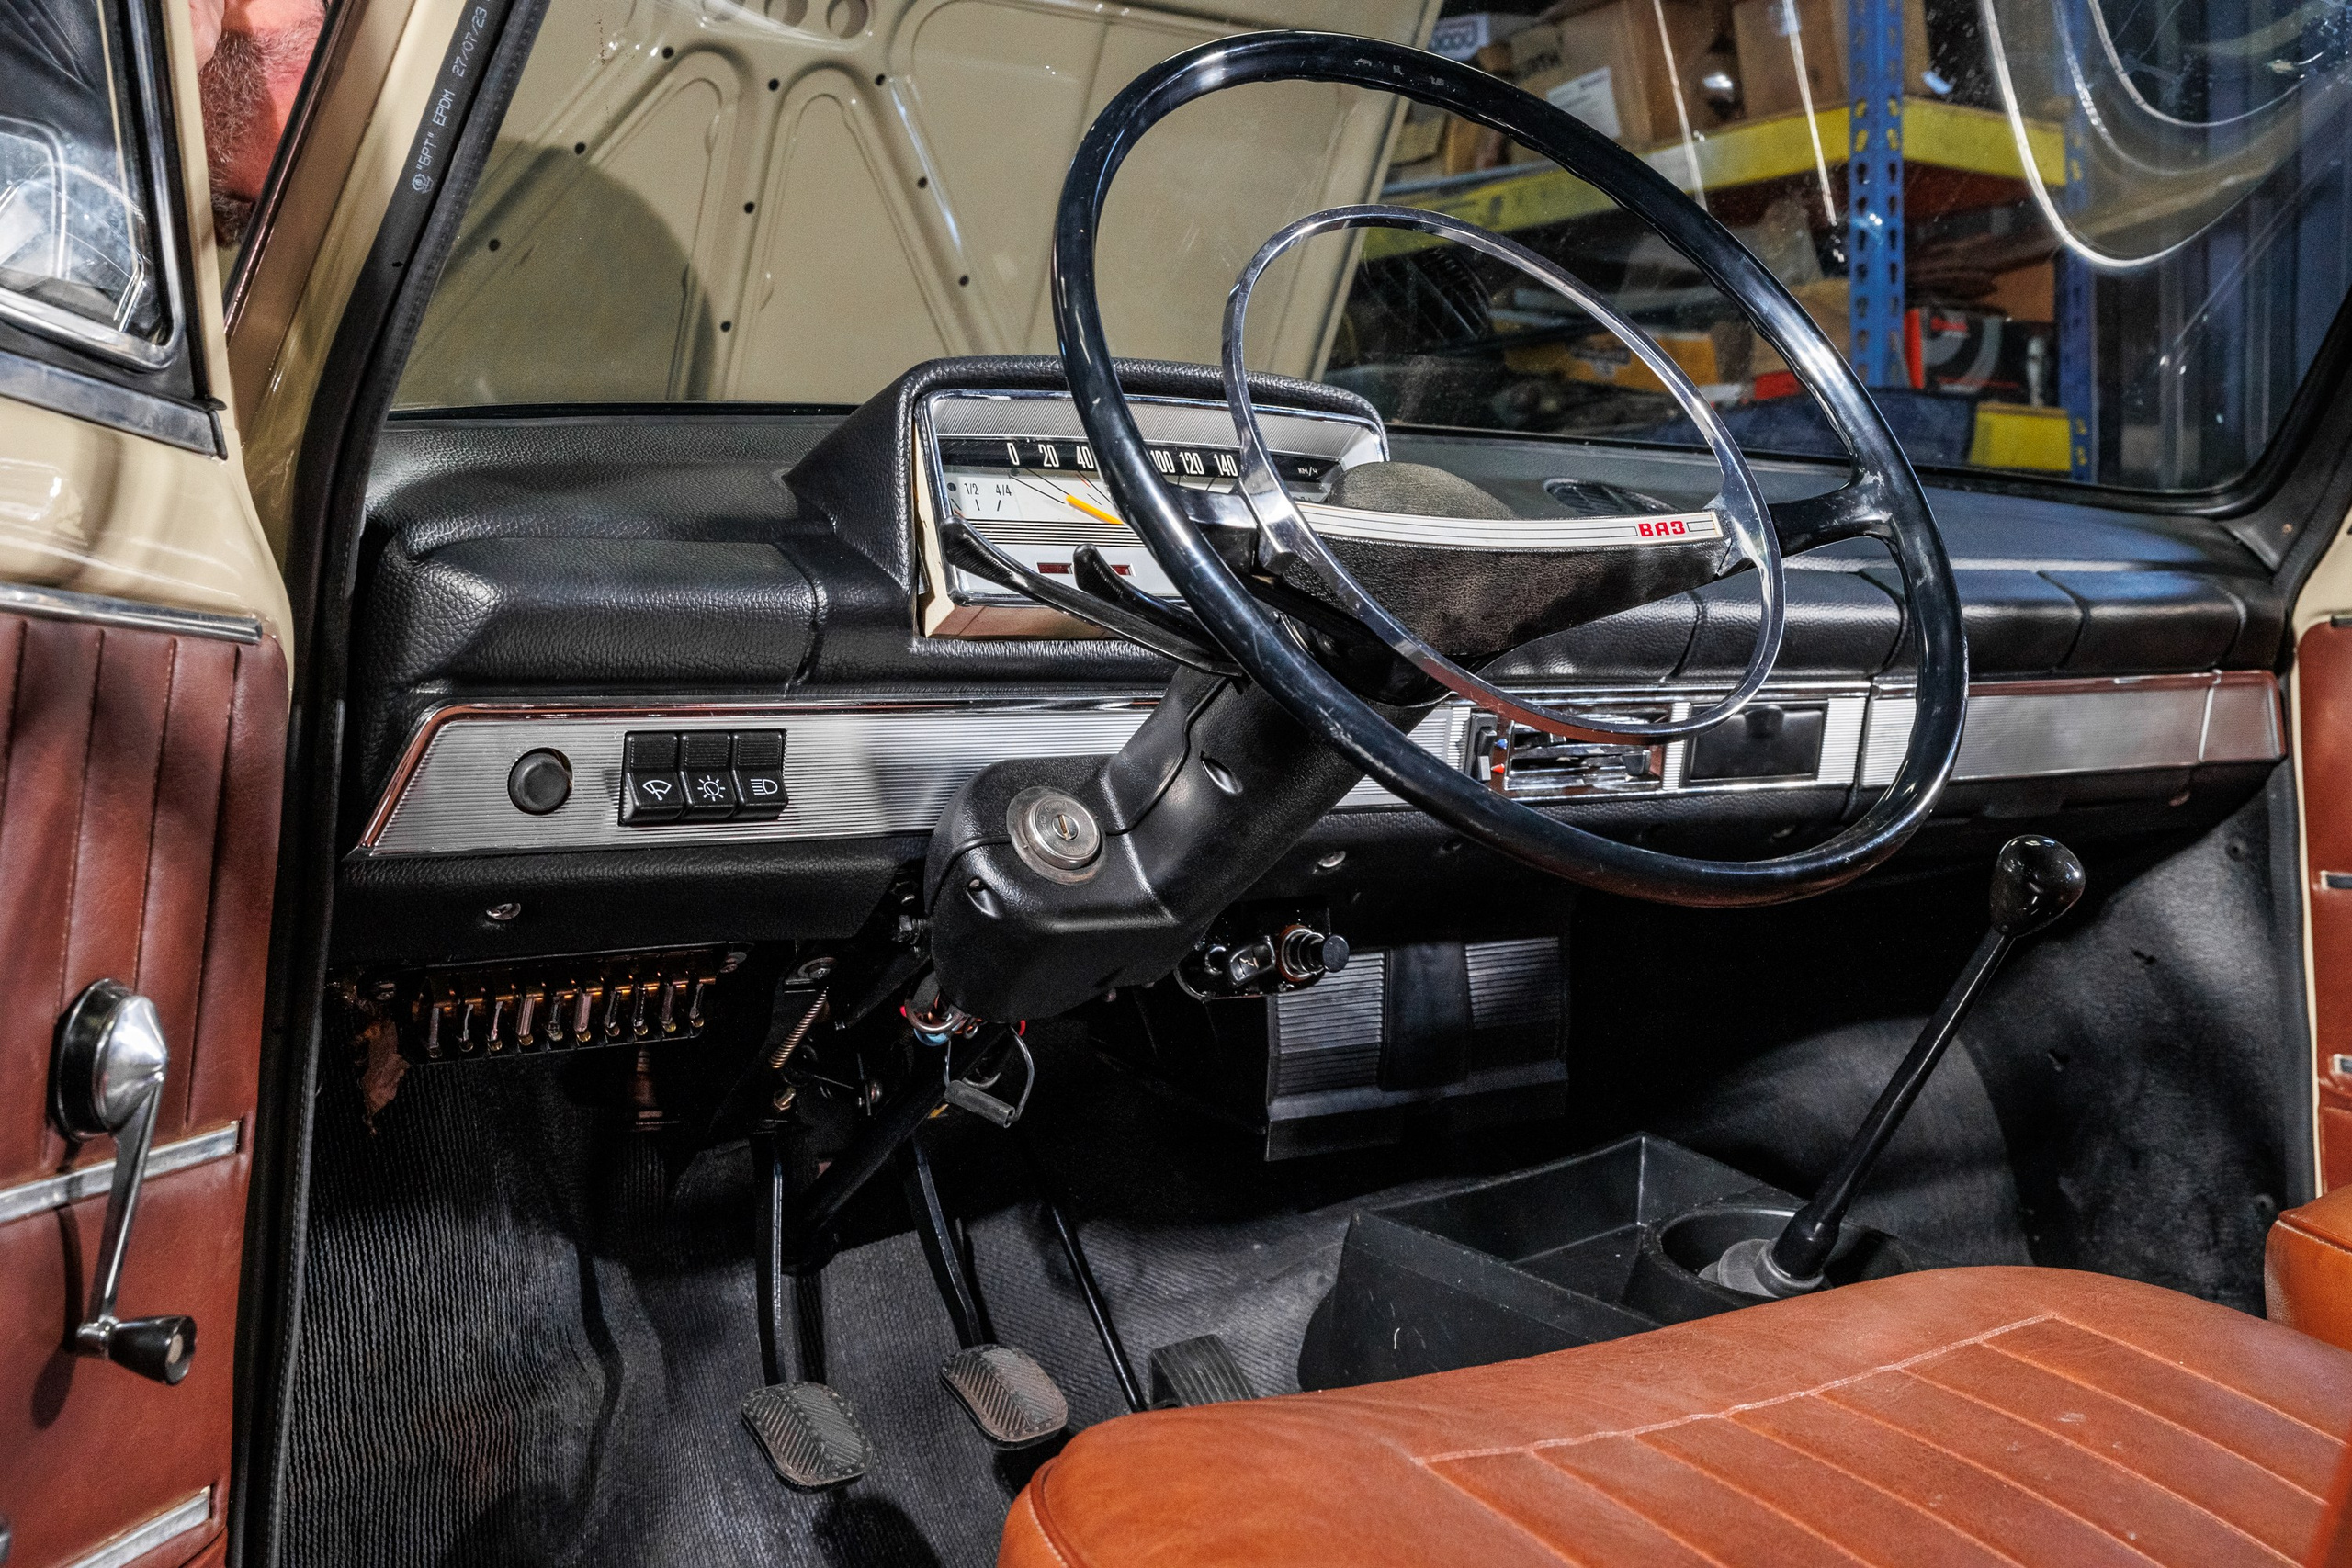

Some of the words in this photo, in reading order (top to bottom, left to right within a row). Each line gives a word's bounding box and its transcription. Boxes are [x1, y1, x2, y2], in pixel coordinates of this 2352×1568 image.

[433, 89, 455, 126] EPDM
[452, 6, 487, 77] 27/07/23
[1007, 443, 1020, 466] 0
[1038, 444, 1059, 468] 20
[1076, 446, 1094, 469] 40
[1150, 450, 1176, 474] 100
[1179, 451, 1205, 475] 120
[1213, 454, 1238, 477] 140
[964, 483, 979, 495] 1/2
[995, 484, 1012, 496] 4/4
[1638, 520, 1686, 537] ВАЗ
